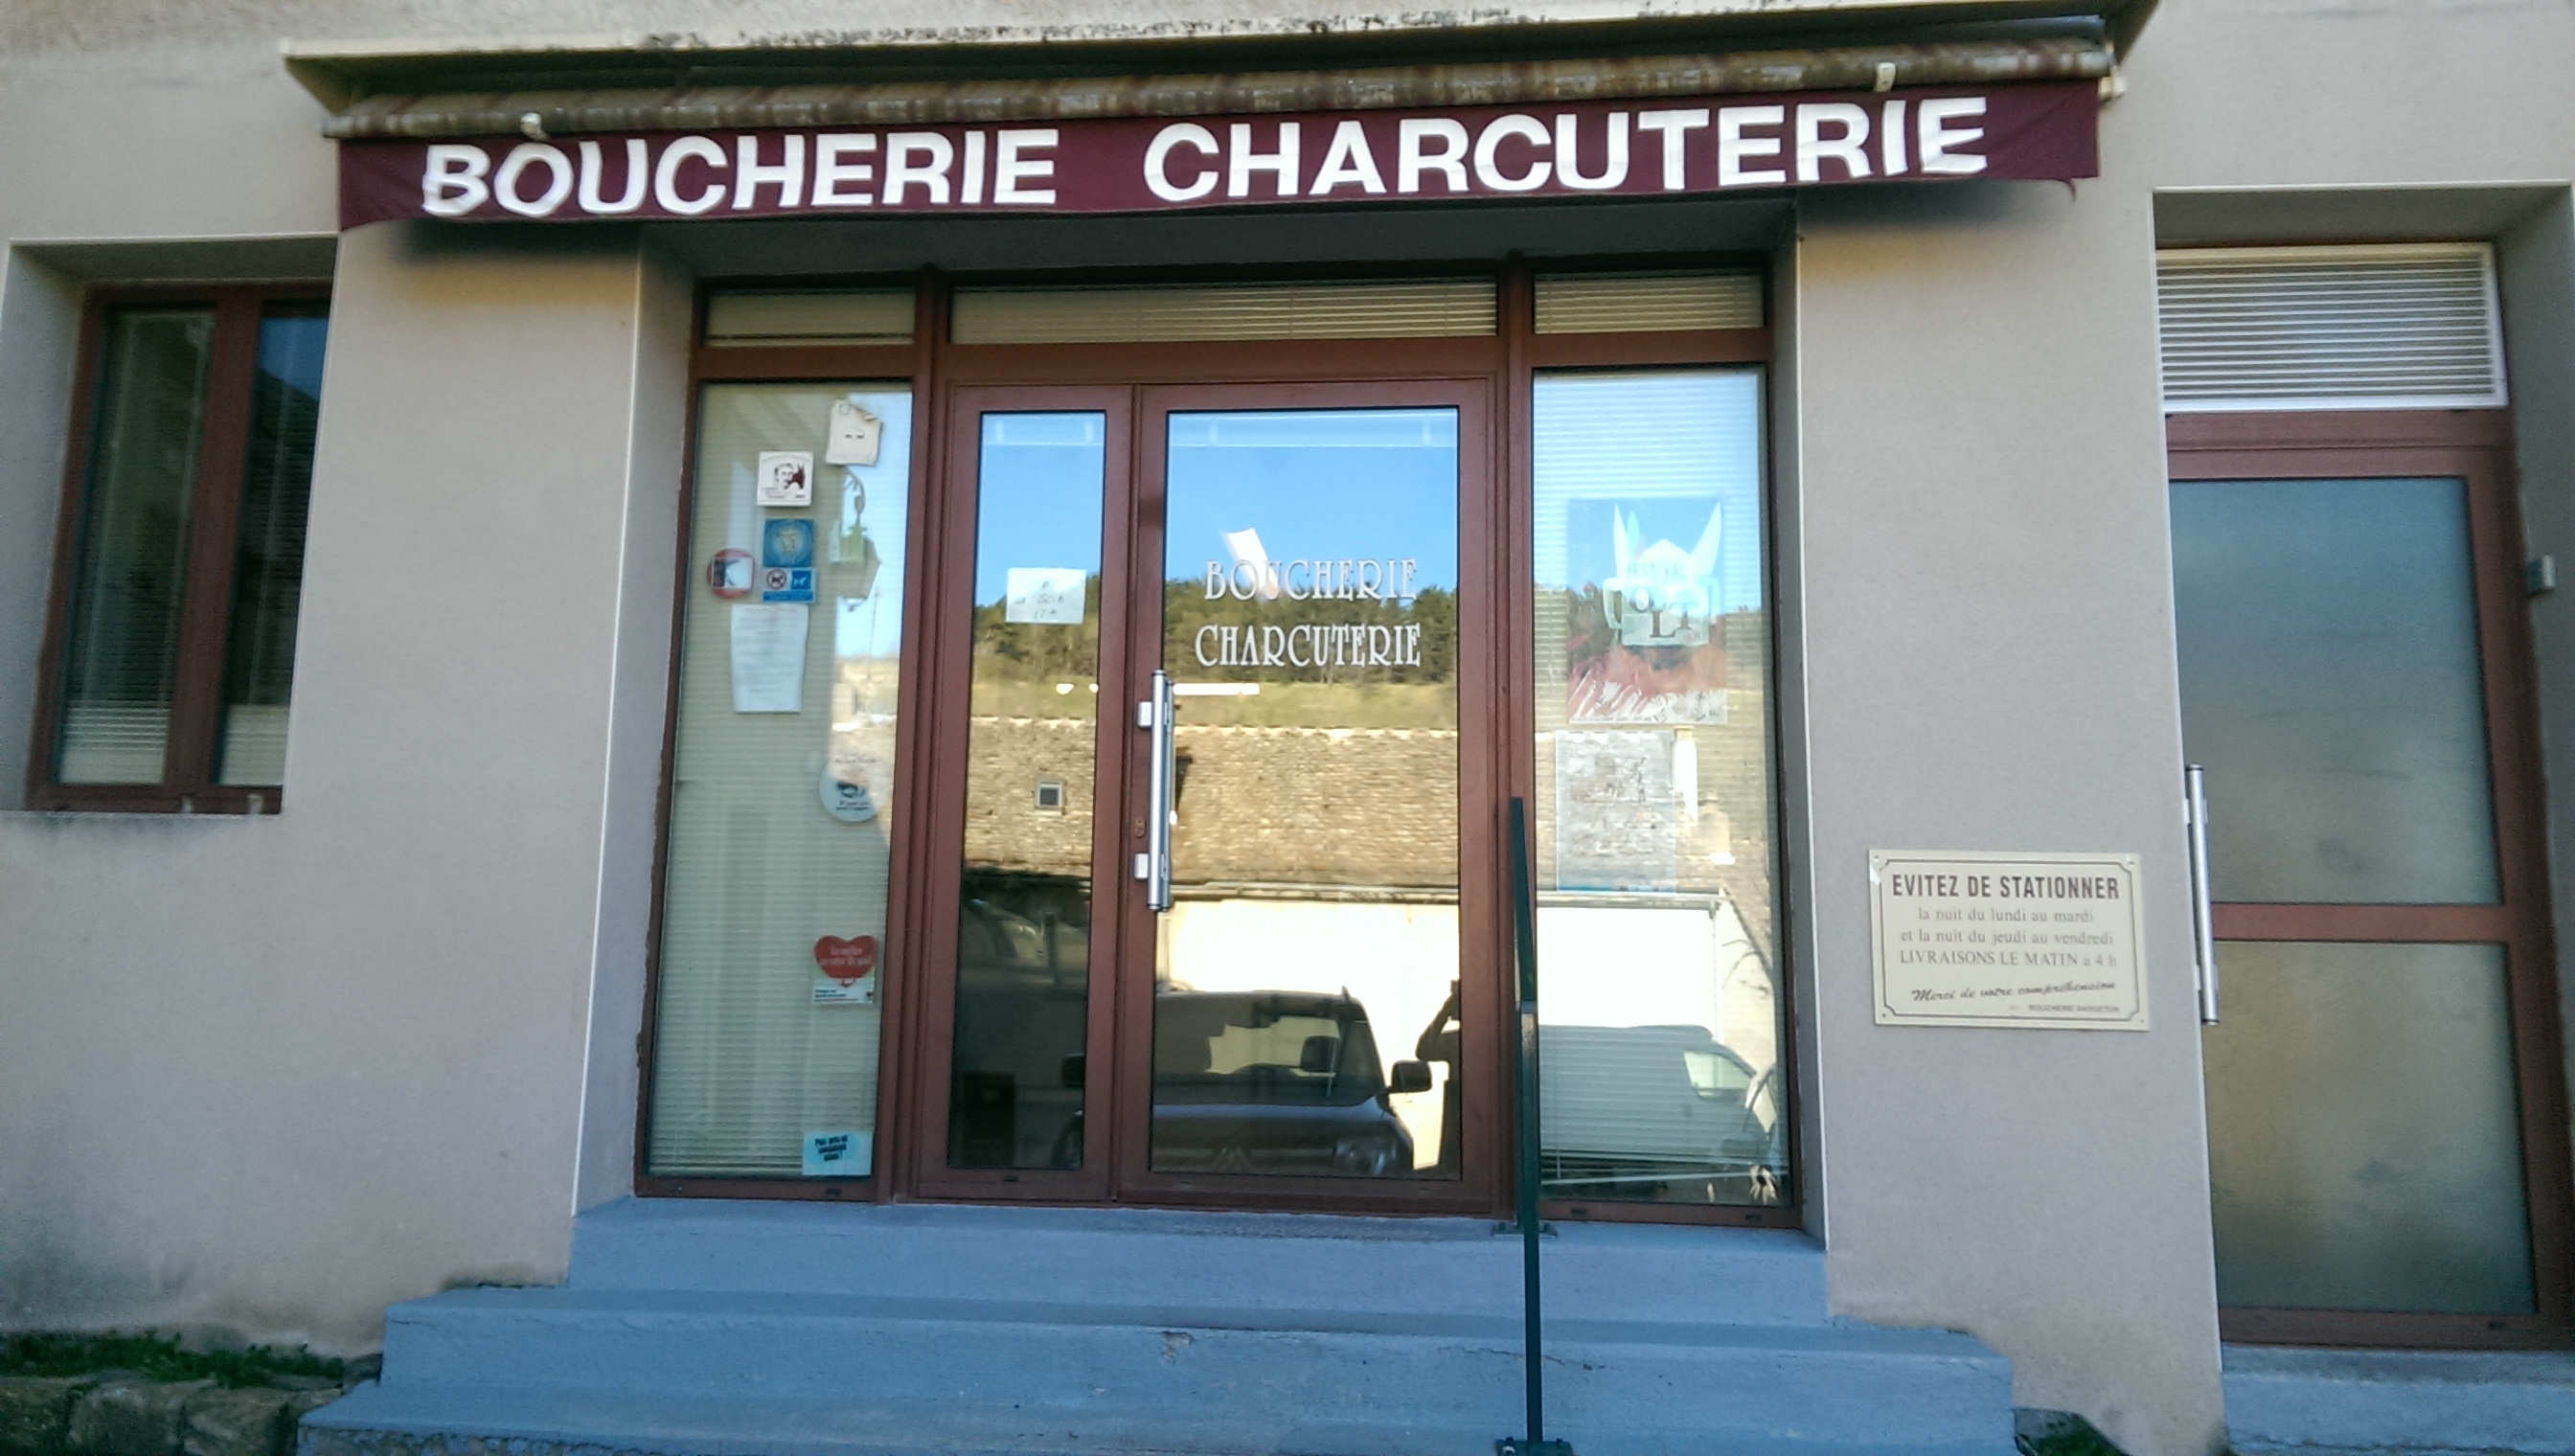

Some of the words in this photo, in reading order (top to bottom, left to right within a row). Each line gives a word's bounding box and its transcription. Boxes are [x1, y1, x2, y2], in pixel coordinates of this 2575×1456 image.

[422, 128, 1060, 218] BOUCHERIE
[1143, 96, 1988, 202] CHARCUTERIE
[1628, 562, 1686, 577] FESTIVAL
[1204, 558, 1417, 601] BOUCHERIE
[1195, 623, 1422, 668] CHARCUTERIE
[1892, 874, 1959, 897] EVITEZ
[1968, 876, 1992, 898] DE
[1999, 876, 2120, 899] STATIONNER
[1918, 907, 1930, 921] la
[1936, 907, 1962, 921] nuit
[1968, 908, 1985, 921] du
[1991, 907, 2026, 921] lundi
[2032, 910, 2048, 922] au
[2054, 909, 2094, 923] mardi
[1901, 930, 1913, 943] et
[1919, 928, 1930, 943] la
[1936, 929, 1963, 944] nuit
[1969, 929, 1986, 944] du
[1992, 929, 2026, 947] jeudi
[2032, 931, 2048, 944] au
[2054, 931, 2113, 945] vendredi
[1900, 949, 1995, 966] LIVRAISONS
[2000, 952, 2018, 966] LE
[2024, 953, 2078, 967] MATIN
[2095, 954, 2104, 967] 4
[2108, 955, 2117, 967] h
[1911, 989, 1955, 1001] Merci
[1960, 987, 1975, 998] de
[1980, 987, 2013, 996] votre
